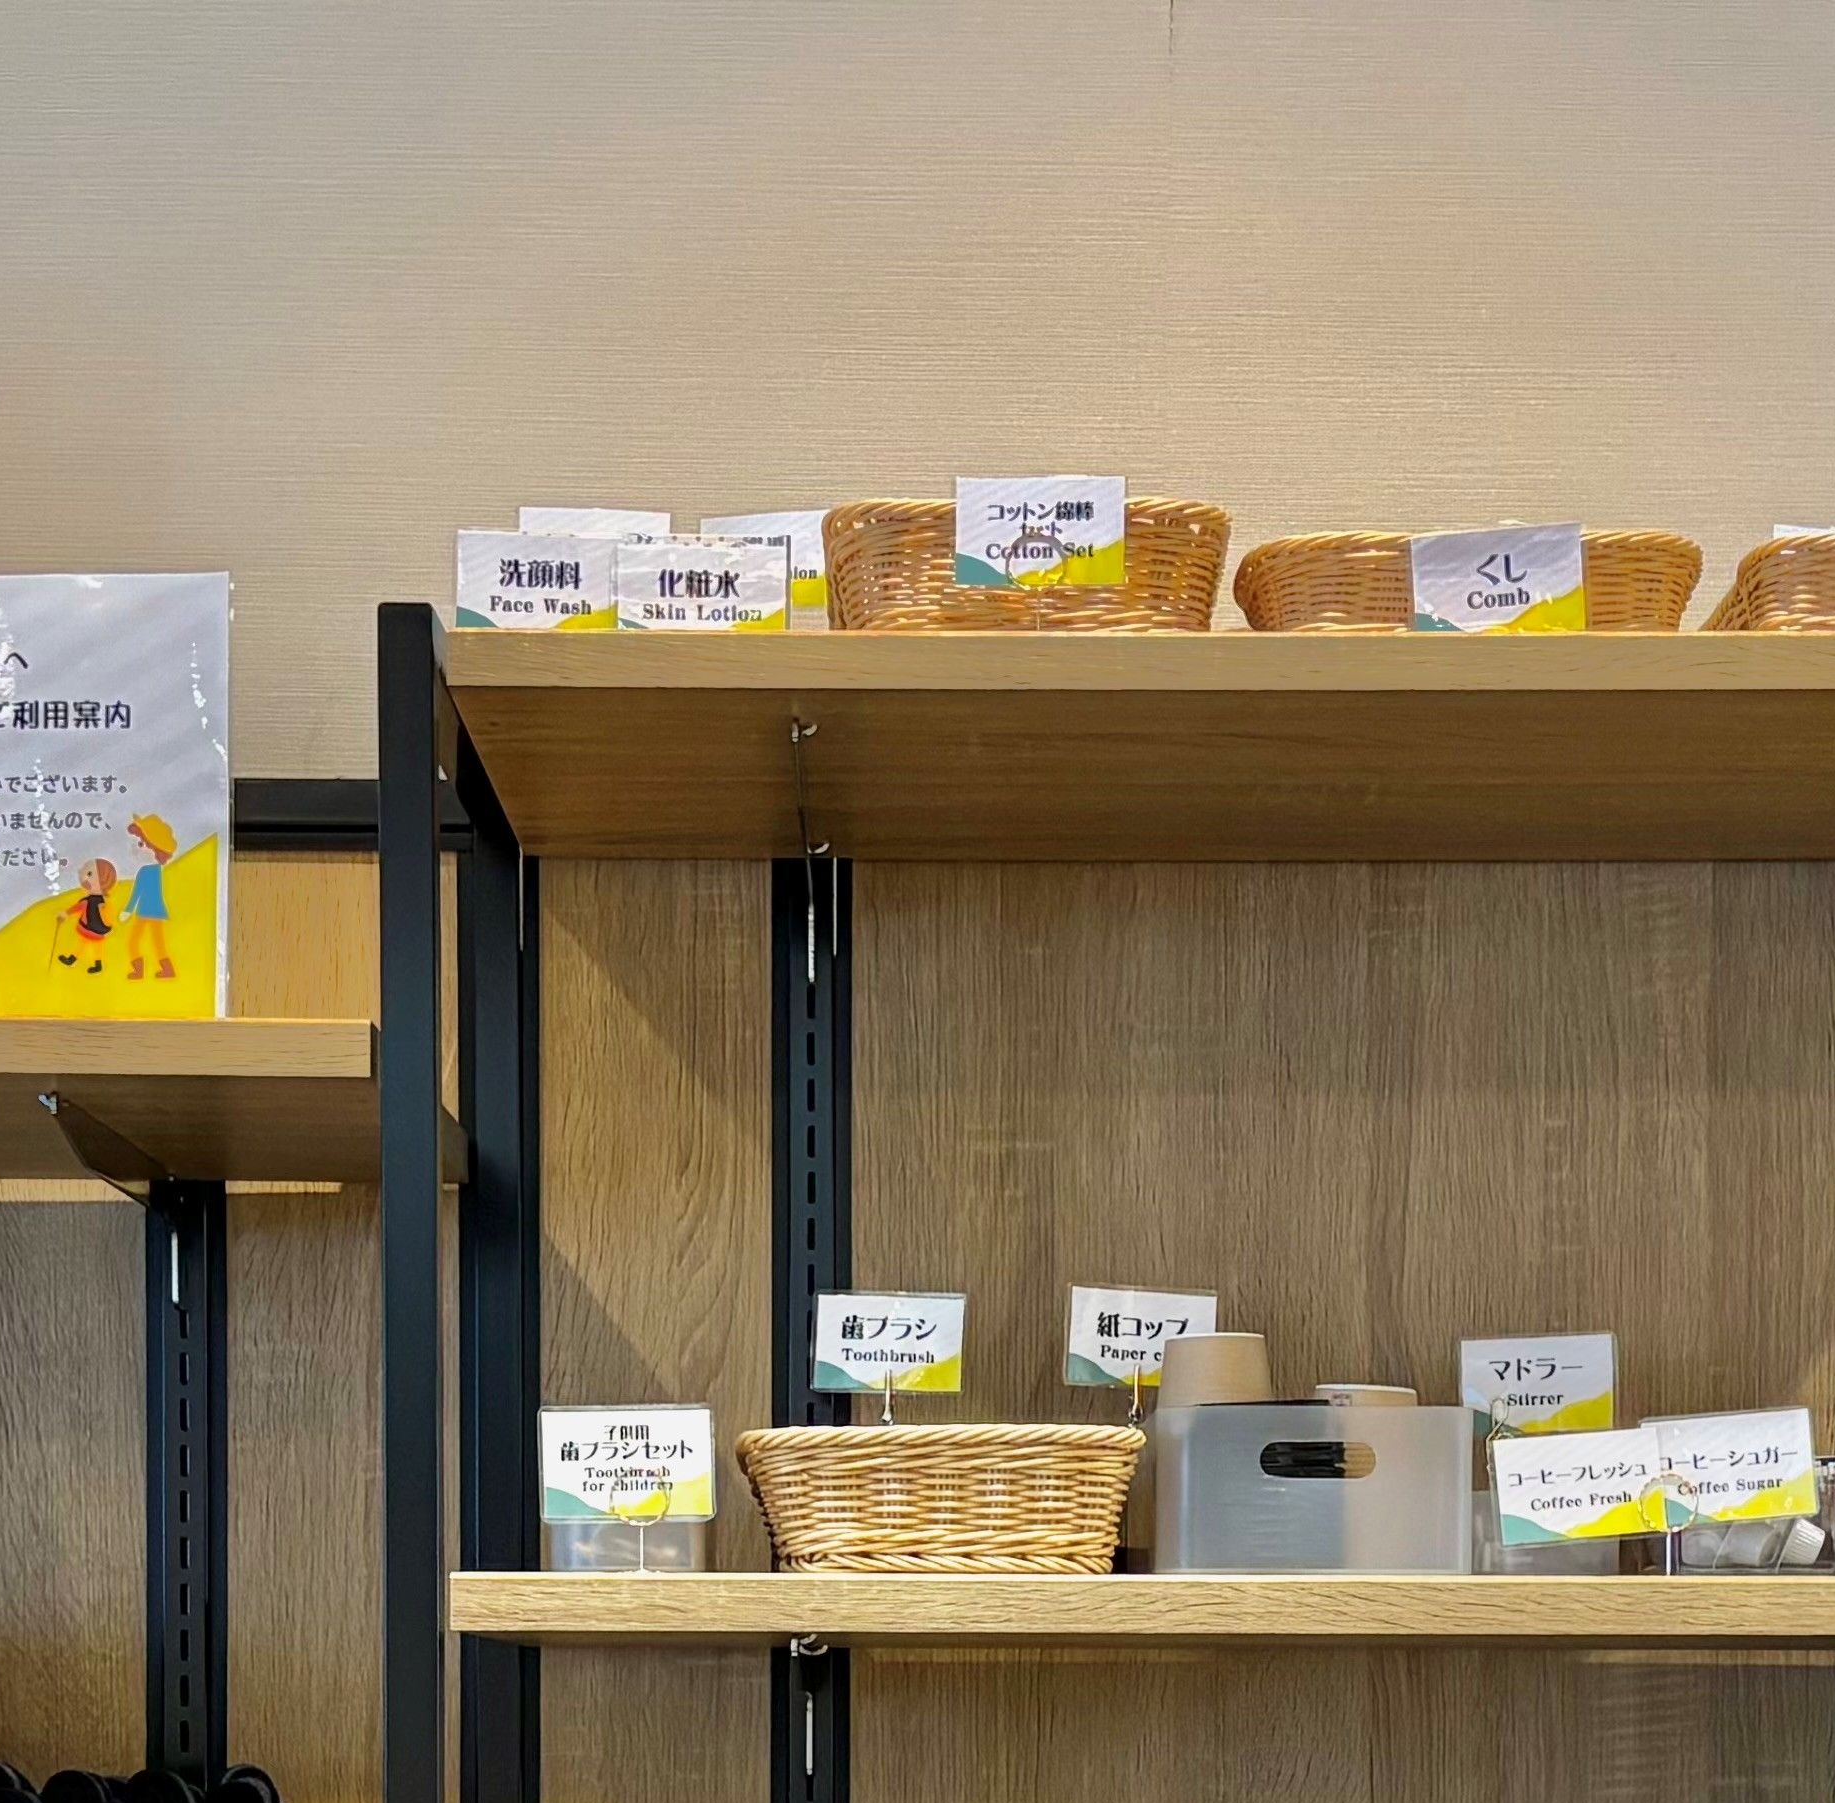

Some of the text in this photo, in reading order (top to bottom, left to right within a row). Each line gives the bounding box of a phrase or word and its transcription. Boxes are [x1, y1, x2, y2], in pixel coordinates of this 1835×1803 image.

[987, 500, 1094, 521] コットン綿棒
[985, 541, 1094, 559] Cotton Set
[498, 558, 582, 591] 洗顔料
[1475, 553, 1528, 586] くし
[657, 568, 741, 600] 化粧水
[489, 595, 592, 616] Face Wash
[1466, 589, 1531, 610] Comb
[642, 603, 762, 622] Skin Lotion
[841, 1314, 937, 1342] 歯ブラシ
[1097, 1311, 1189, 1340] 紙コップ
[842, 1347, 935, 1364] Toothbrush
[1101, 1344, 1146, 1361] Paper
[1489, 1358, 1583, 1381] マドラー
[1507, 1393, 1564, 1406] Stirrer
[604, 1424, 649, 1440] 子供用
[561, 1439, 693, 1461] 歯ブラシセット
[1660, 1446, 1798, 1472] コーヒーシュガー
[1508, 1461, 1647, 1488] コーヒーフレッシュ
[583, 1481, 605, 1491] for
[1677, 1477, 1783, 1496] Coffee Sugar
[1530, 1492, 1632, 1512] Coffee Fresh
